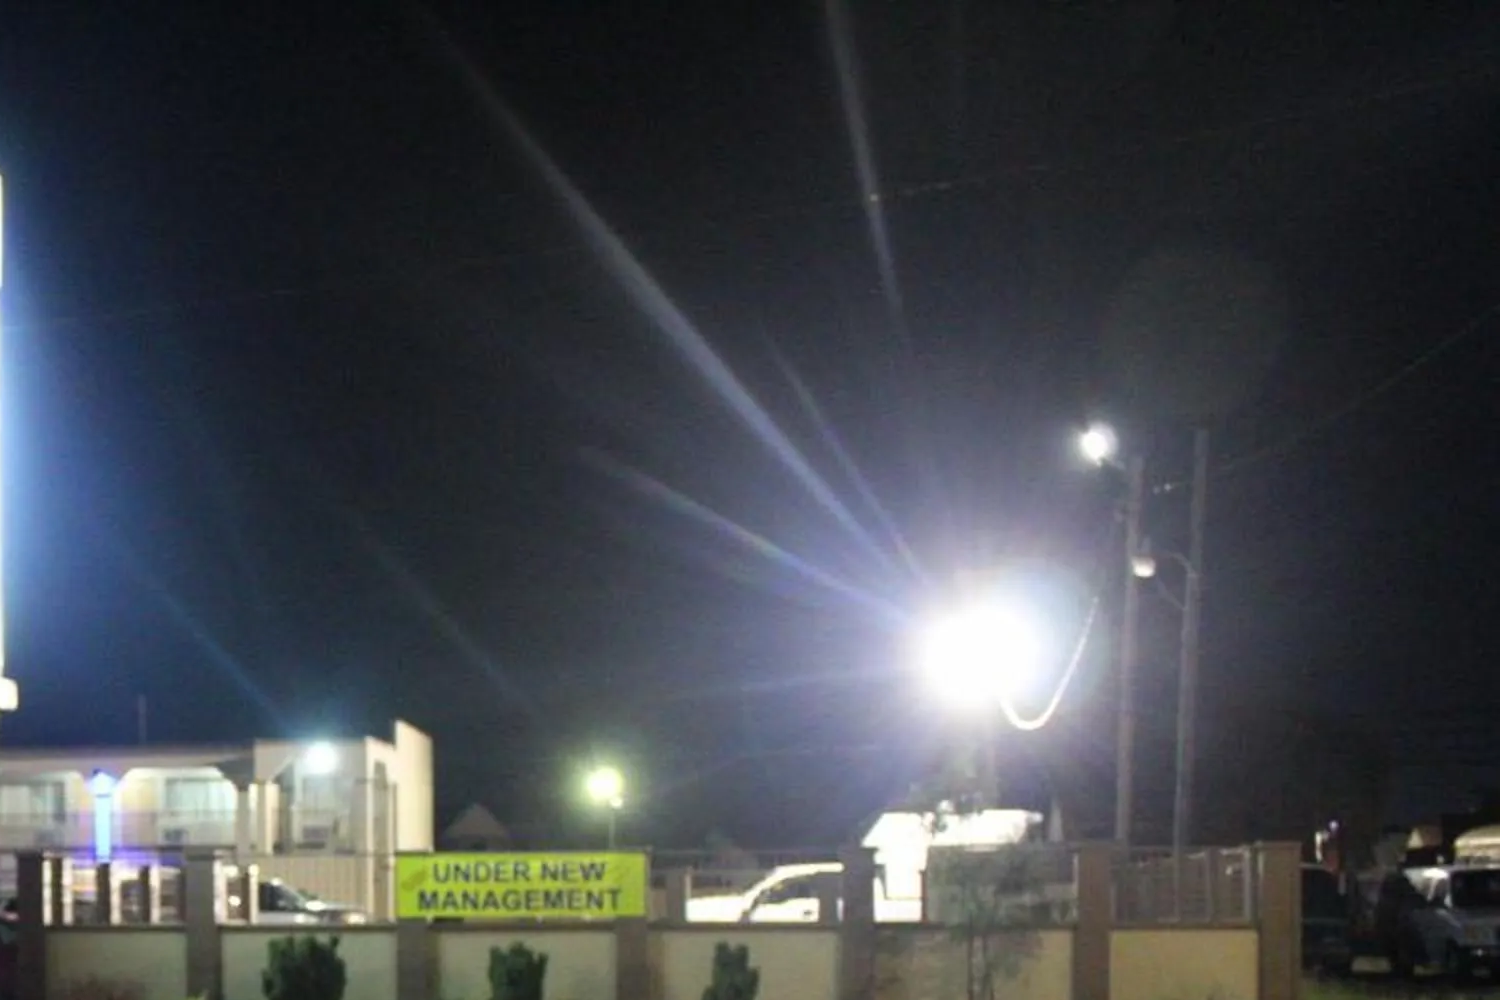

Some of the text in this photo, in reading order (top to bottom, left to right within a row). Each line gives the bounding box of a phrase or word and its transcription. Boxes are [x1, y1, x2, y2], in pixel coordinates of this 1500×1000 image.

[432, 860, 609, 883] UNDER NEW
[417, 888, 623, 911] MANAGEMENT
